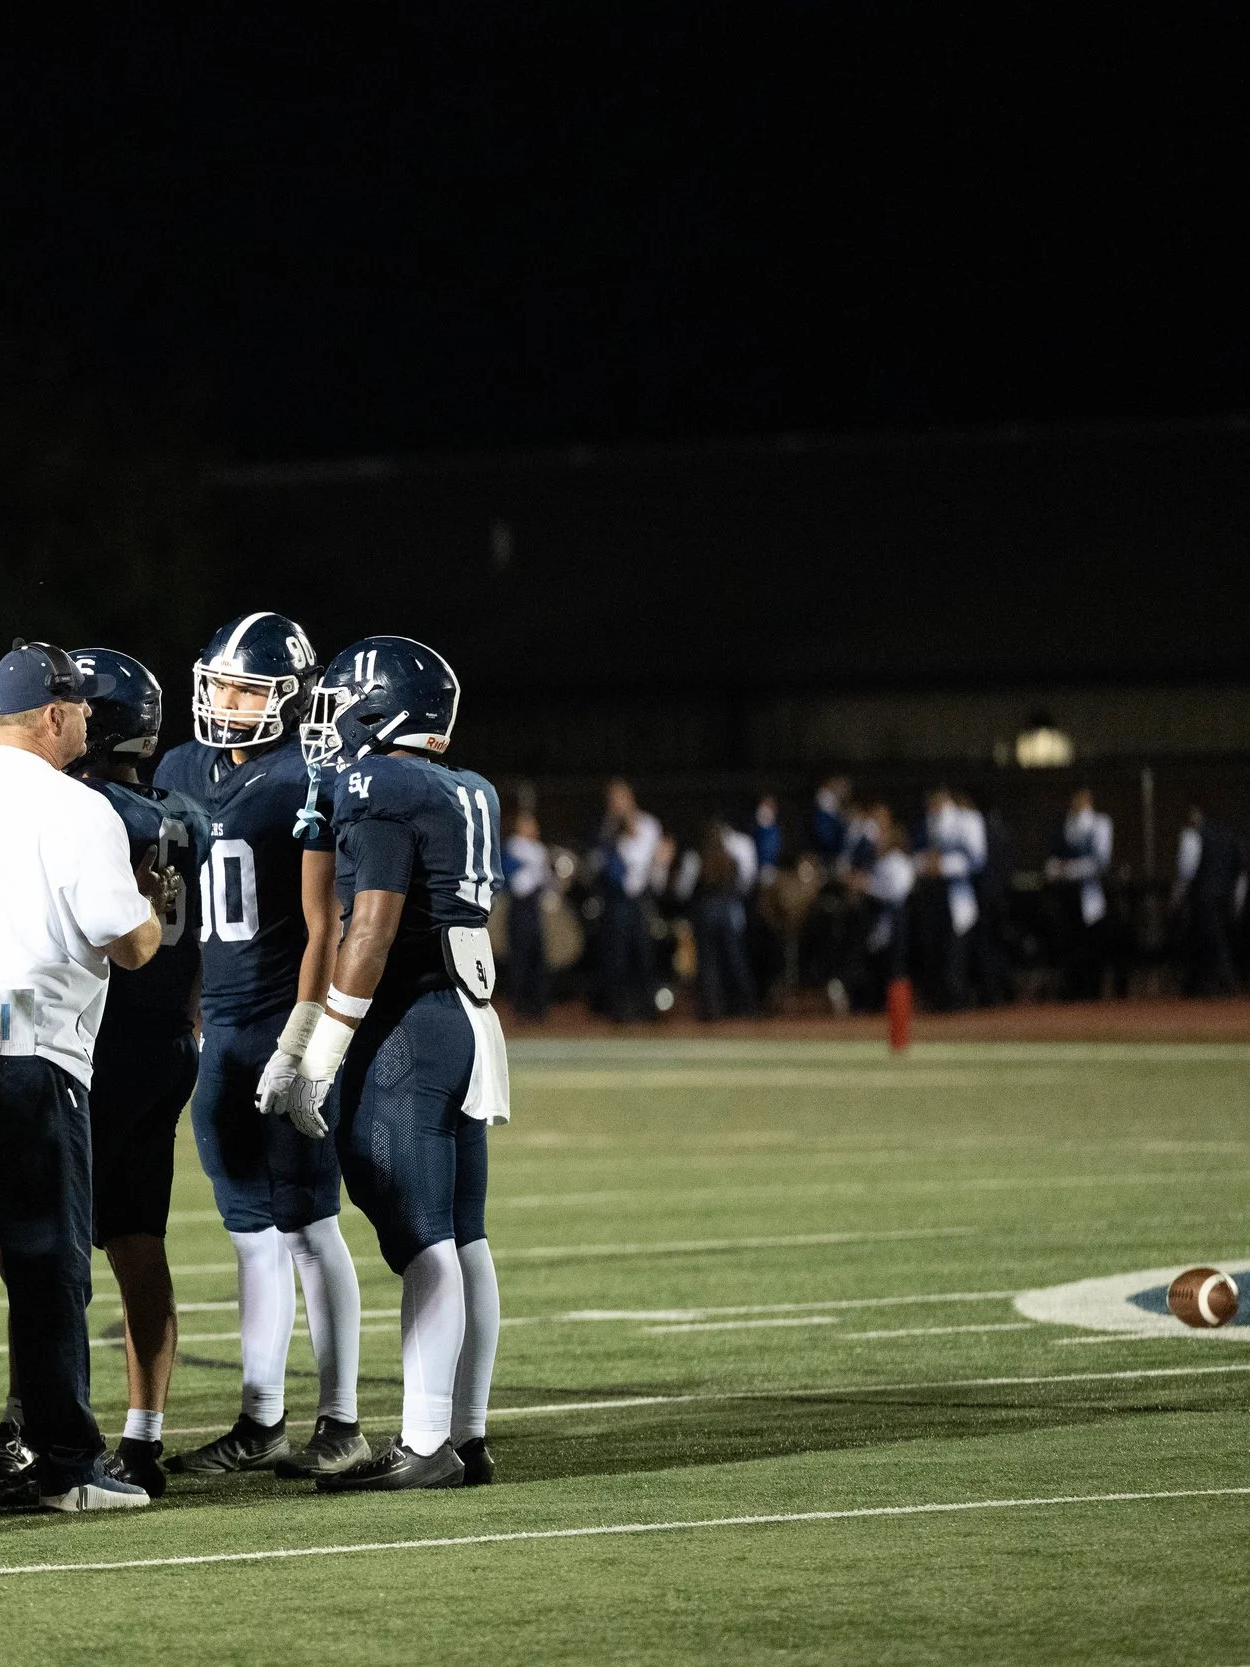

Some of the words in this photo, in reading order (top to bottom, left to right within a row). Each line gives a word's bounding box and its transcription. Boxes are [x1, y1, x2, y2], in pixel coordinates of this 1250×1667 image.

[286, 636, 315, 668] 90
[354, 650, 377, 682] 11
[348, 772, 372, 798] SV
[454, 786, 494, 912] 11
